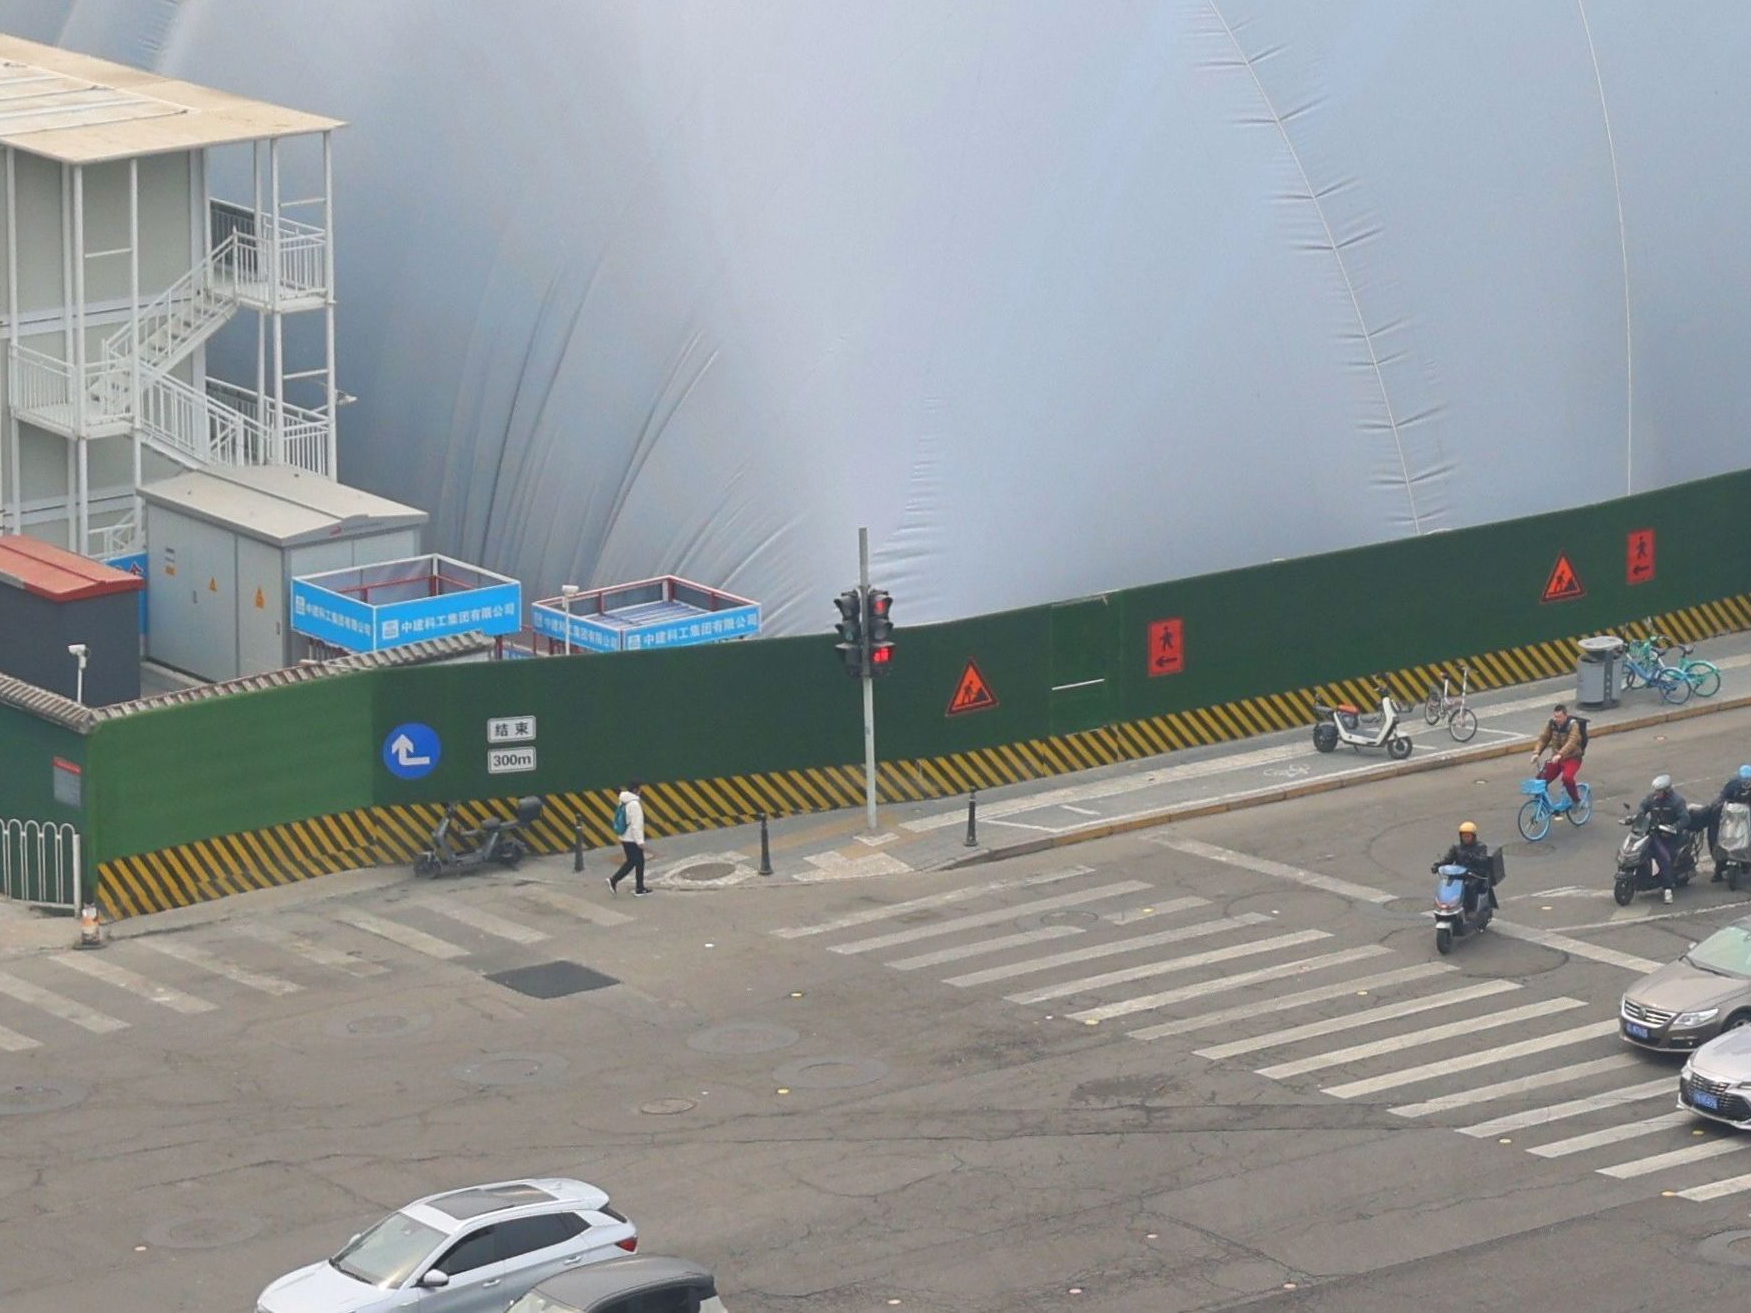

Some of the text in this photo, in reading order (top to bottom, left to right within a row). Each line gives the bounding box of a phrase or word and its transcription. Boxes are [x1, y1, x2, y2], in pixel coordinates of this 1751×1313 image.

[401, 601, 515, 633] 中建科工集团有限公司
[643, 613, 758, 645] 中建科工集团有限公司
[494, 720, 529, 737] 结束
[492, 752, 532, 768] 300m
